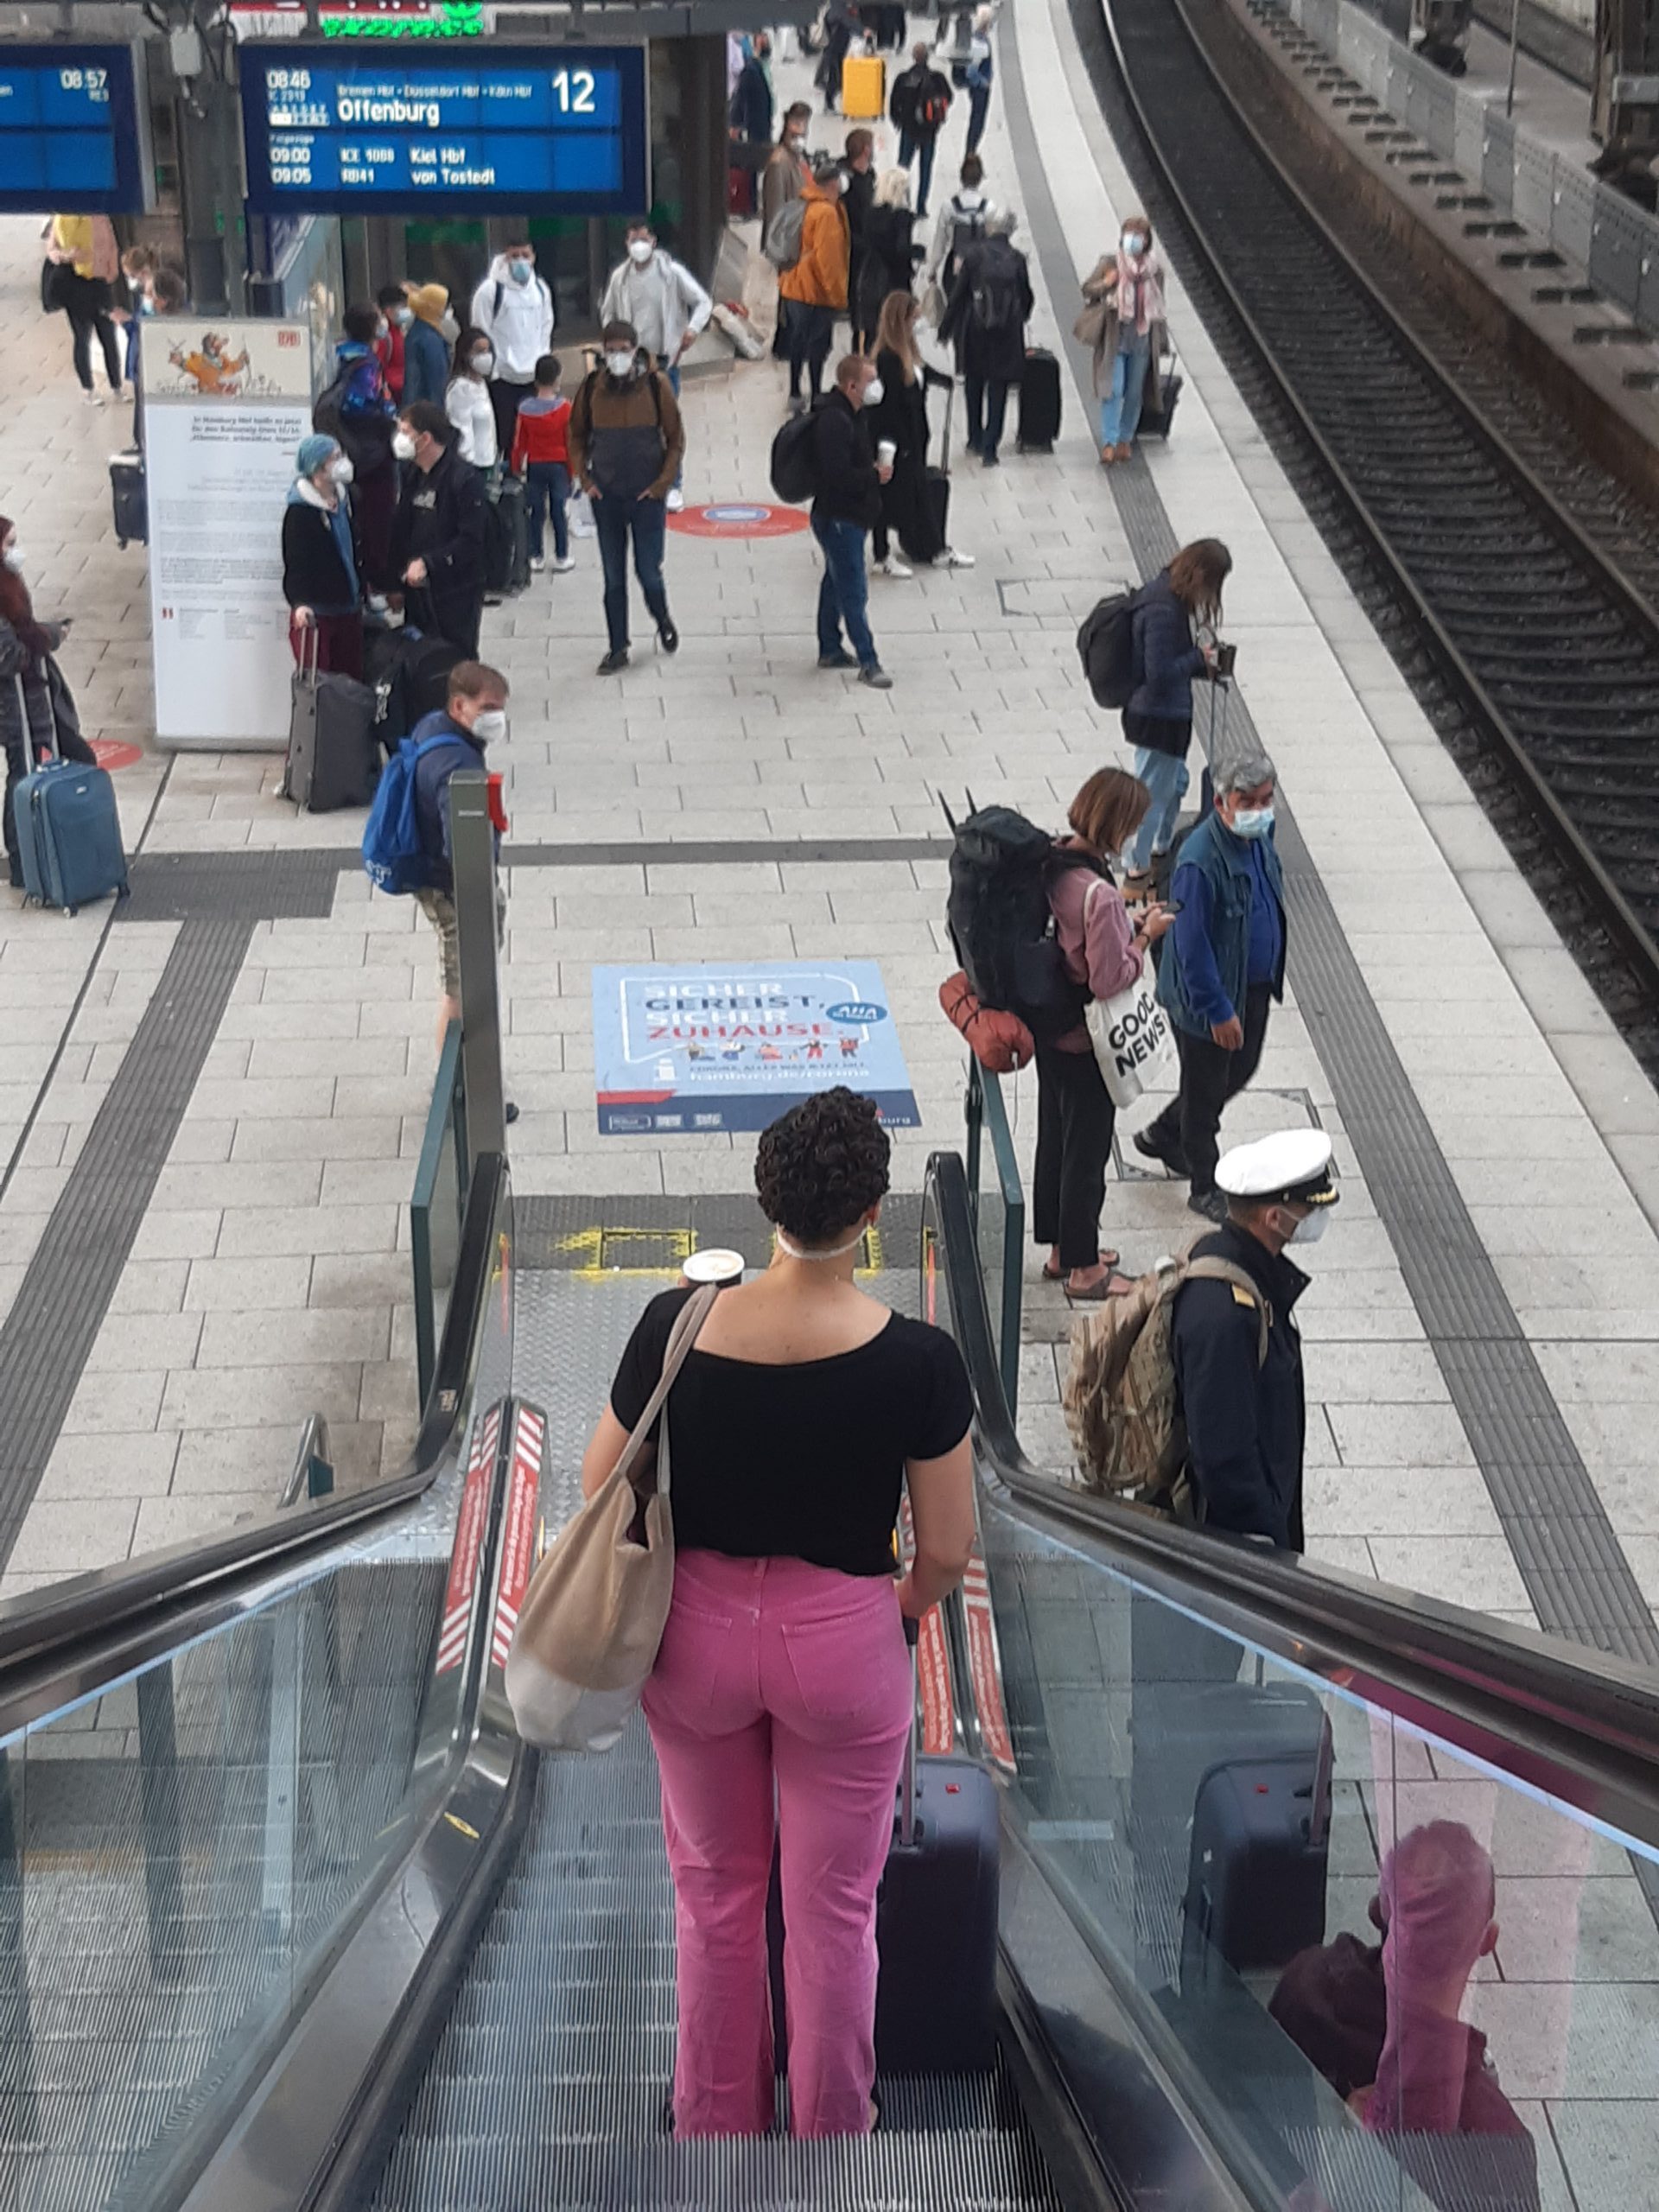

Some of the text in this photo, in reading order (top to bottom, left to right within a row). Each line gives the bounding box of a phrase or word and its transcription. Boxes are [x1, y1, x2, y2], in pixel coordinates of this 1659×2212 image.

[552, 72, 594, 112] 12
[338, 100, 439, 127] Offenburg
[270, 148, 310, 164] 09:00
[410, 148, 436, 164] Kiel
[441, 148, 465, 164] Hbf
[271, 168, 311, 184] 09:05
[410, 171, 436, 184] von
[441, 168, 495, 184] Tostedt
[645, 983, 782, 997] SICHER
[646, 1010, 789, 1024] SICHER
[1115, 1014, 1166, 1078] NEWS
